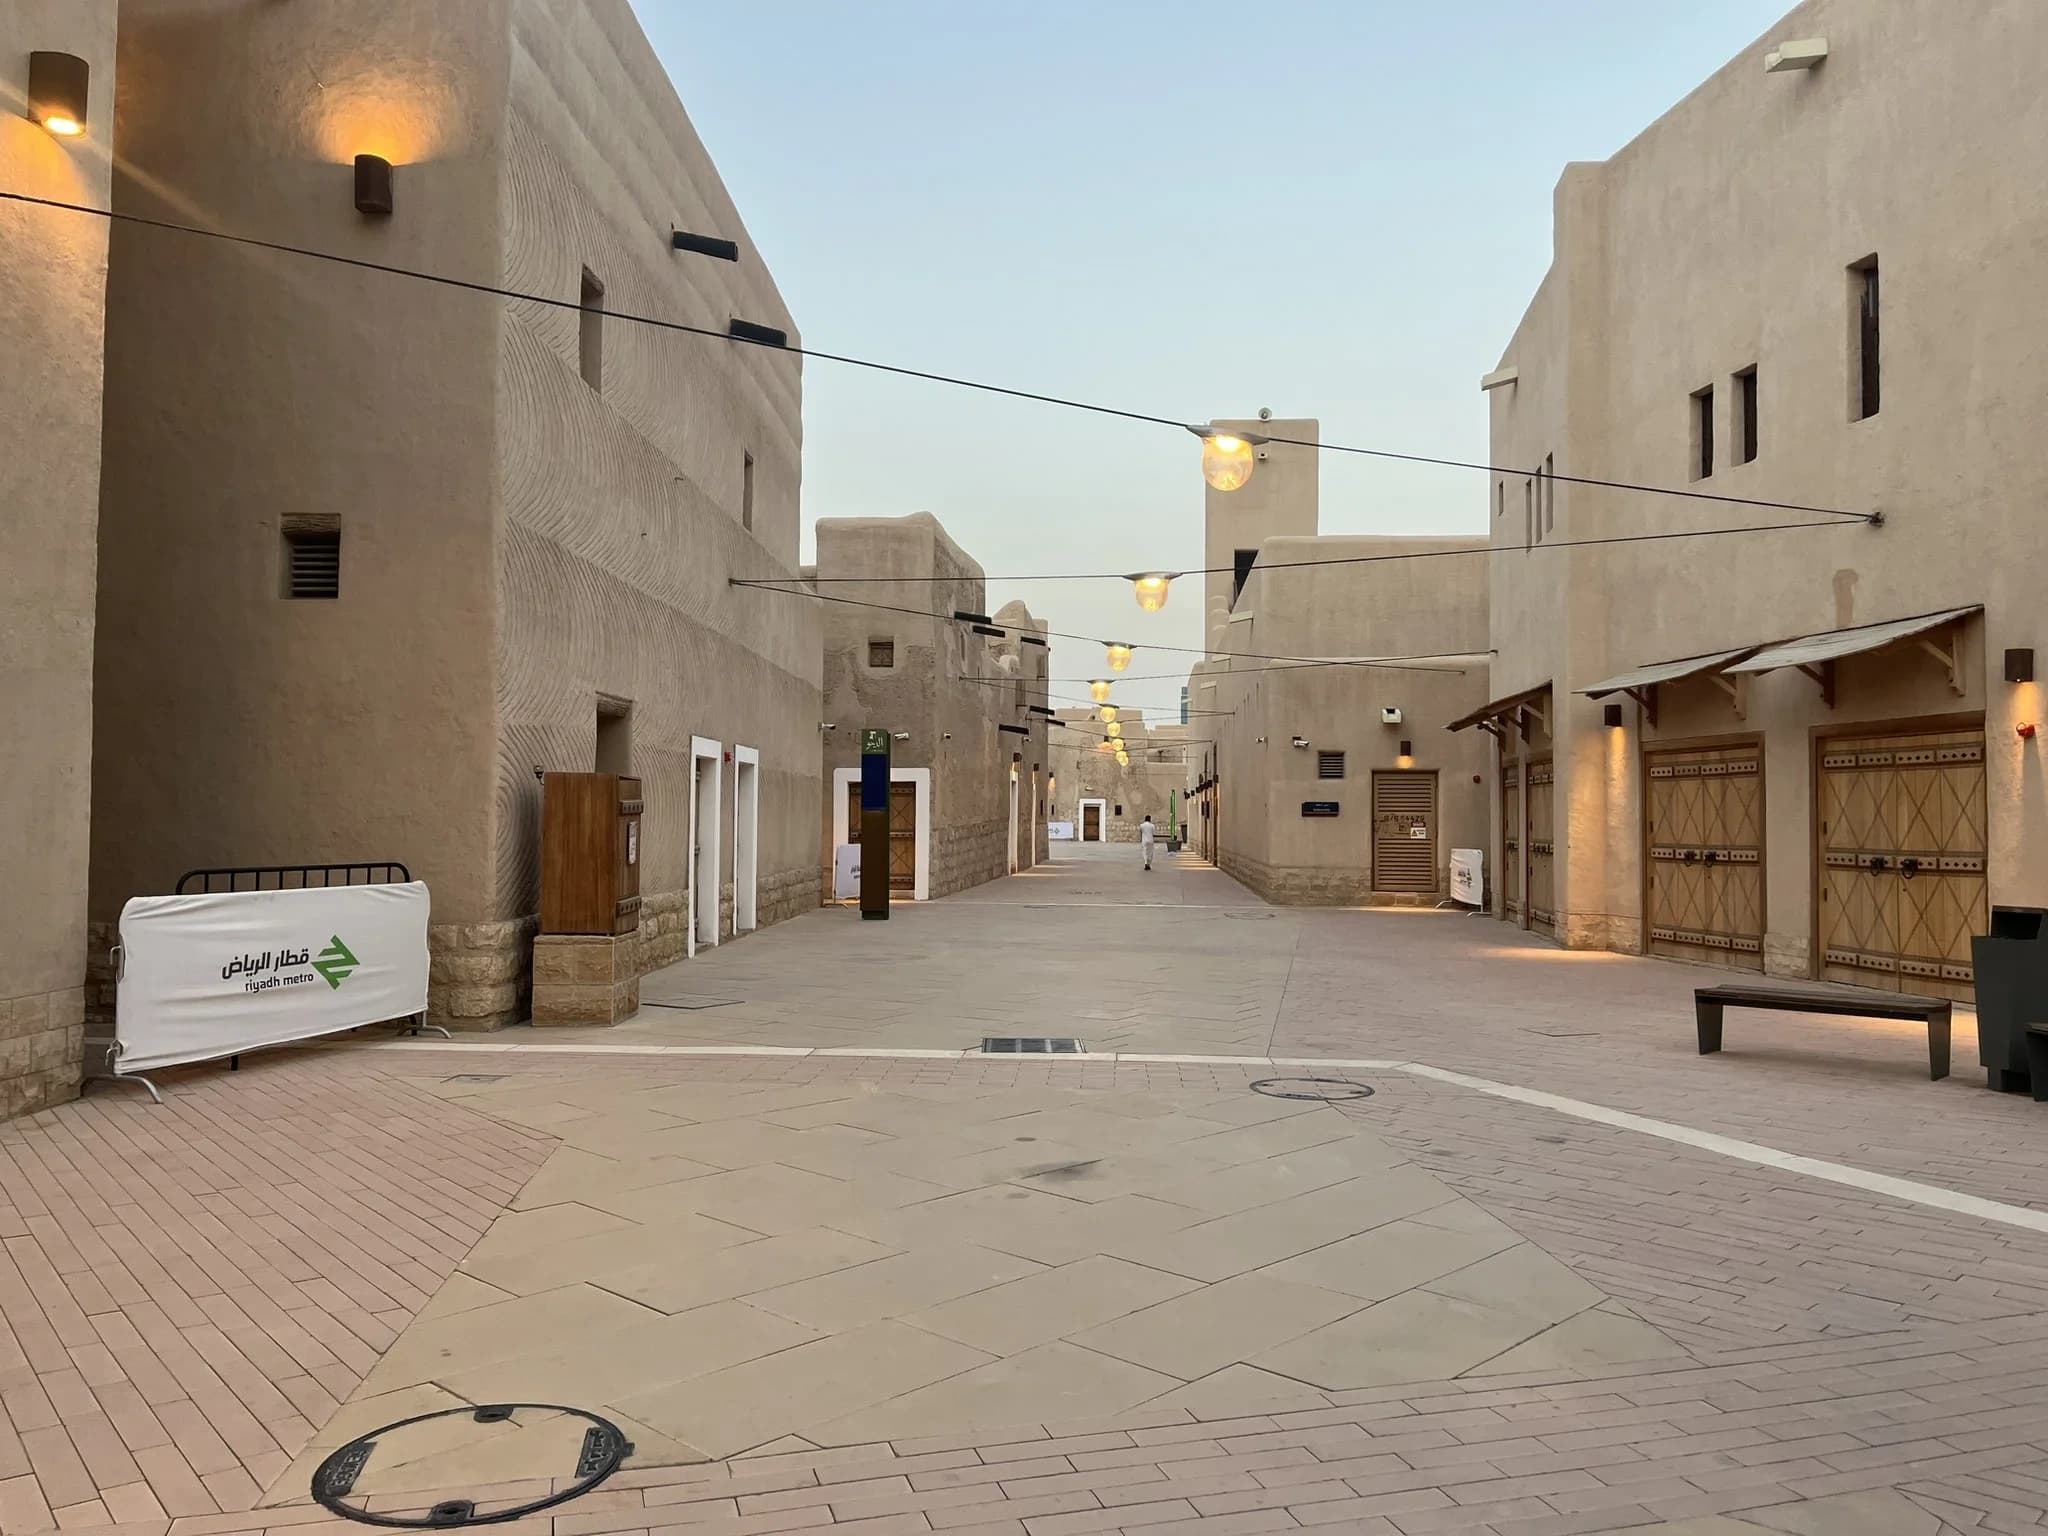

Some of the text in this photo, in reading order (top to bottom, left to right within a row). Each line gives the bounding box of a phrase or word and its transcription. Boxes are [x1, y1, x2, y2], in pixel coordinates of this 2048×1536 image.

[222, 948, 310, 980] قطار الرياض
[245, 973, 314, 993] riyadh metro
